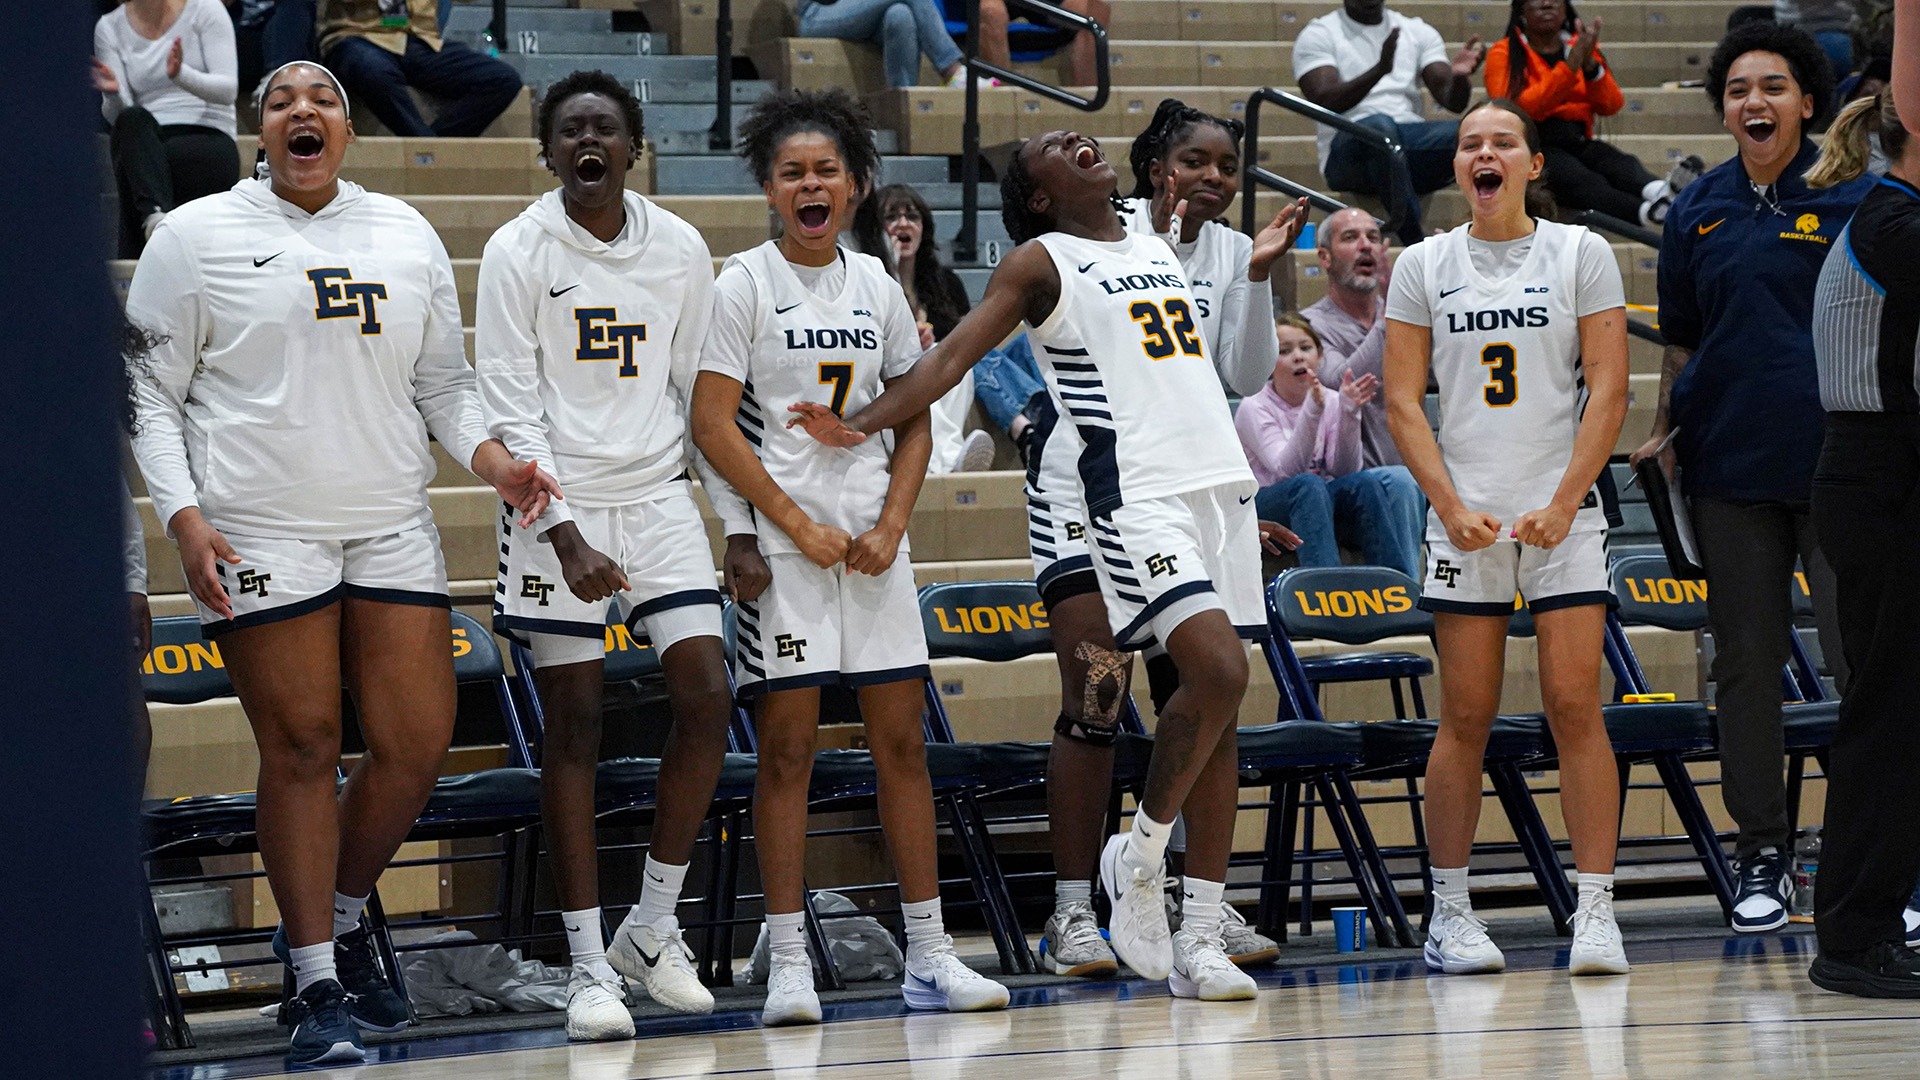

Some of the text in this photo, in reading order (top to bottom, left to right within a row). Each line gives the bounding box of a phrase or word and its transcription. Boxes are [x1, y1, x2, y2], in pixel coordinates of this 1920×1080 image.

[519, 31, 537, 53] 12
[987, 241, 998, 265] 8
[1780, 232, 1828, 244] BASKETBALL
[1099, 273, 1185, 295] LIONS
[306, 267, 389, 336] ET
[1128, 297, 1204, 361] 32
[1447, 306, 1550, 334] LIONS
[573, 306, 647, 378] ET
[784, 328, 878, 350] LIONS
[1480, 341, 1519, 408] 3
[818, 362, 855, 418] 7
[1144, 552, 1179, 579] ET
[1433, 559, 1462, 589] ET
[236, 568, 271, 598] ET
[520, 574, 555, 607] ET
[1625, 577, 1708, 604] LION
[1295, 585, 1413, 618] LIONS
[774, 633, 807, 663] ET
